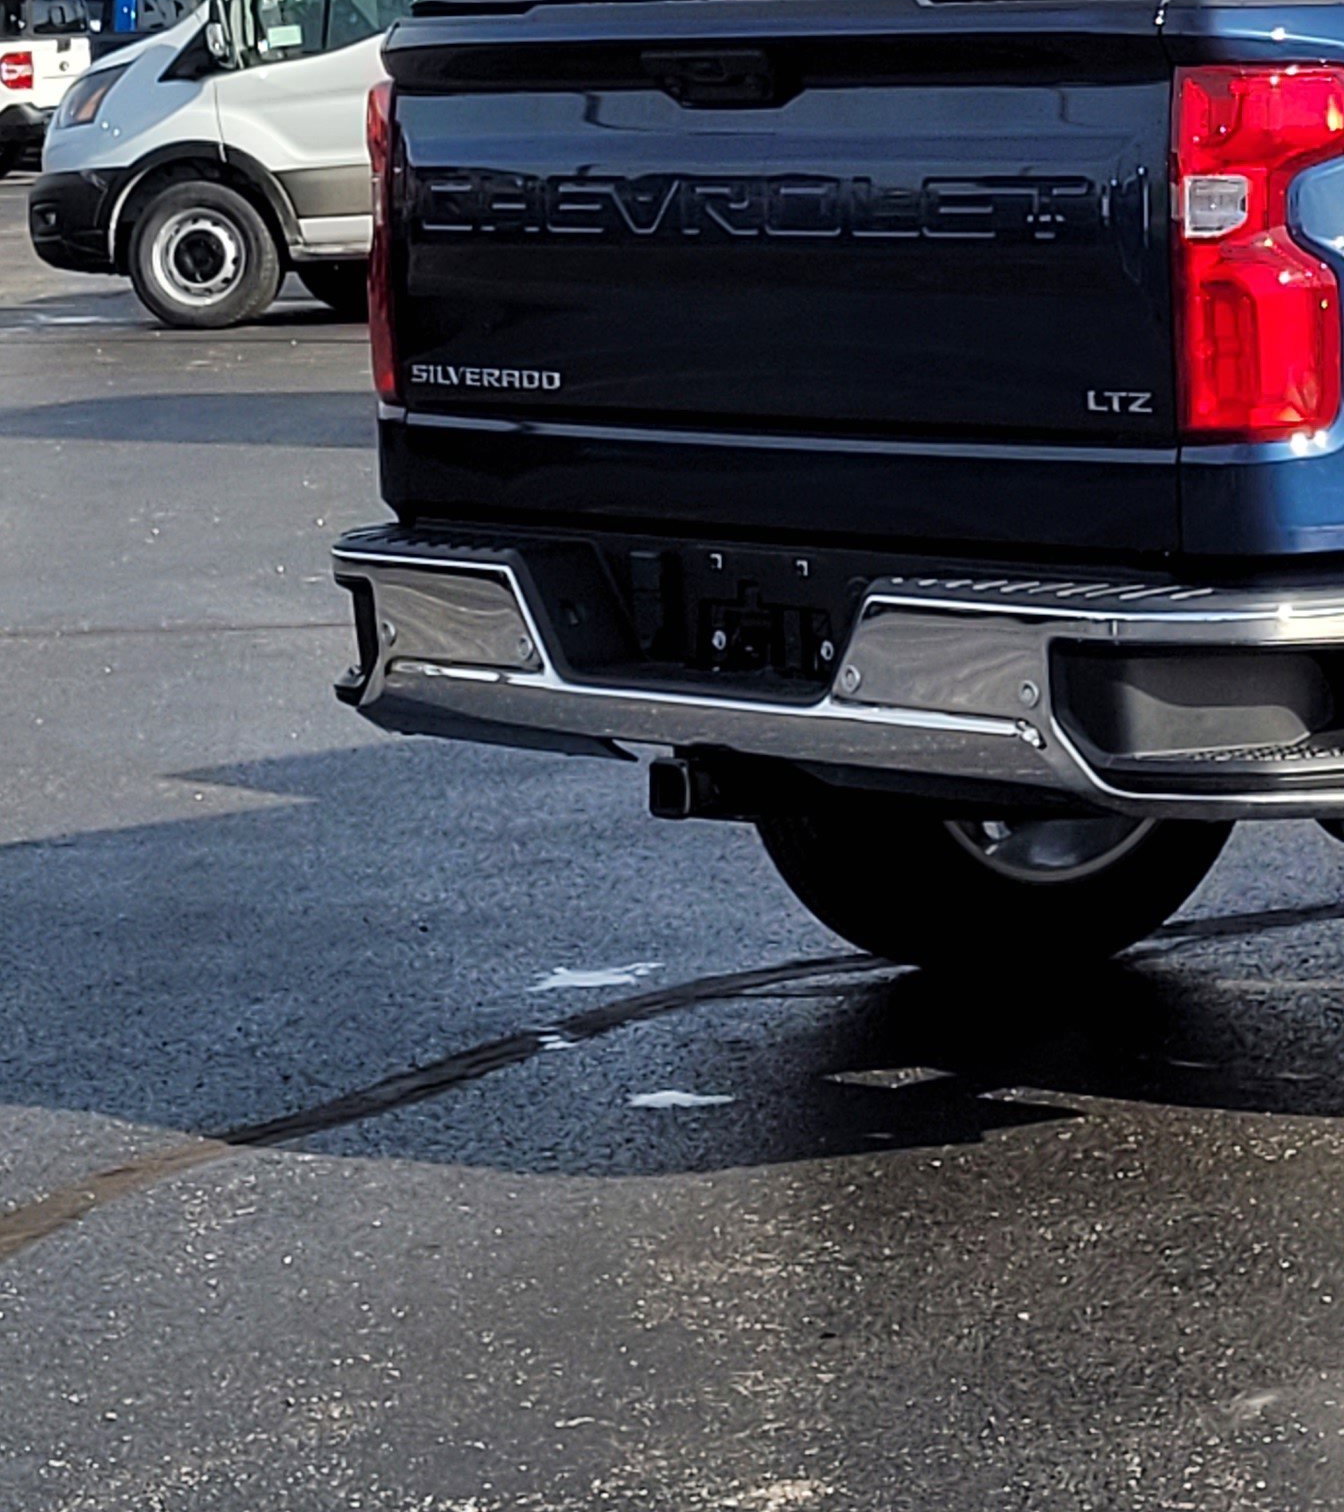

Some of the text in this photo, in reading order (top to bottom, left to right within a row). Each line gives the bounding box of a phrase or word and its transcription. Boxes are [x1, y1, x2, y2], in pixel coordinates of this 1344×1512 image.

[422, 176, 1090, 240] CHEVROLET
[411, 364, 561, 390] SILVERADO
[1087, 390, 1153, 413] LTZ
